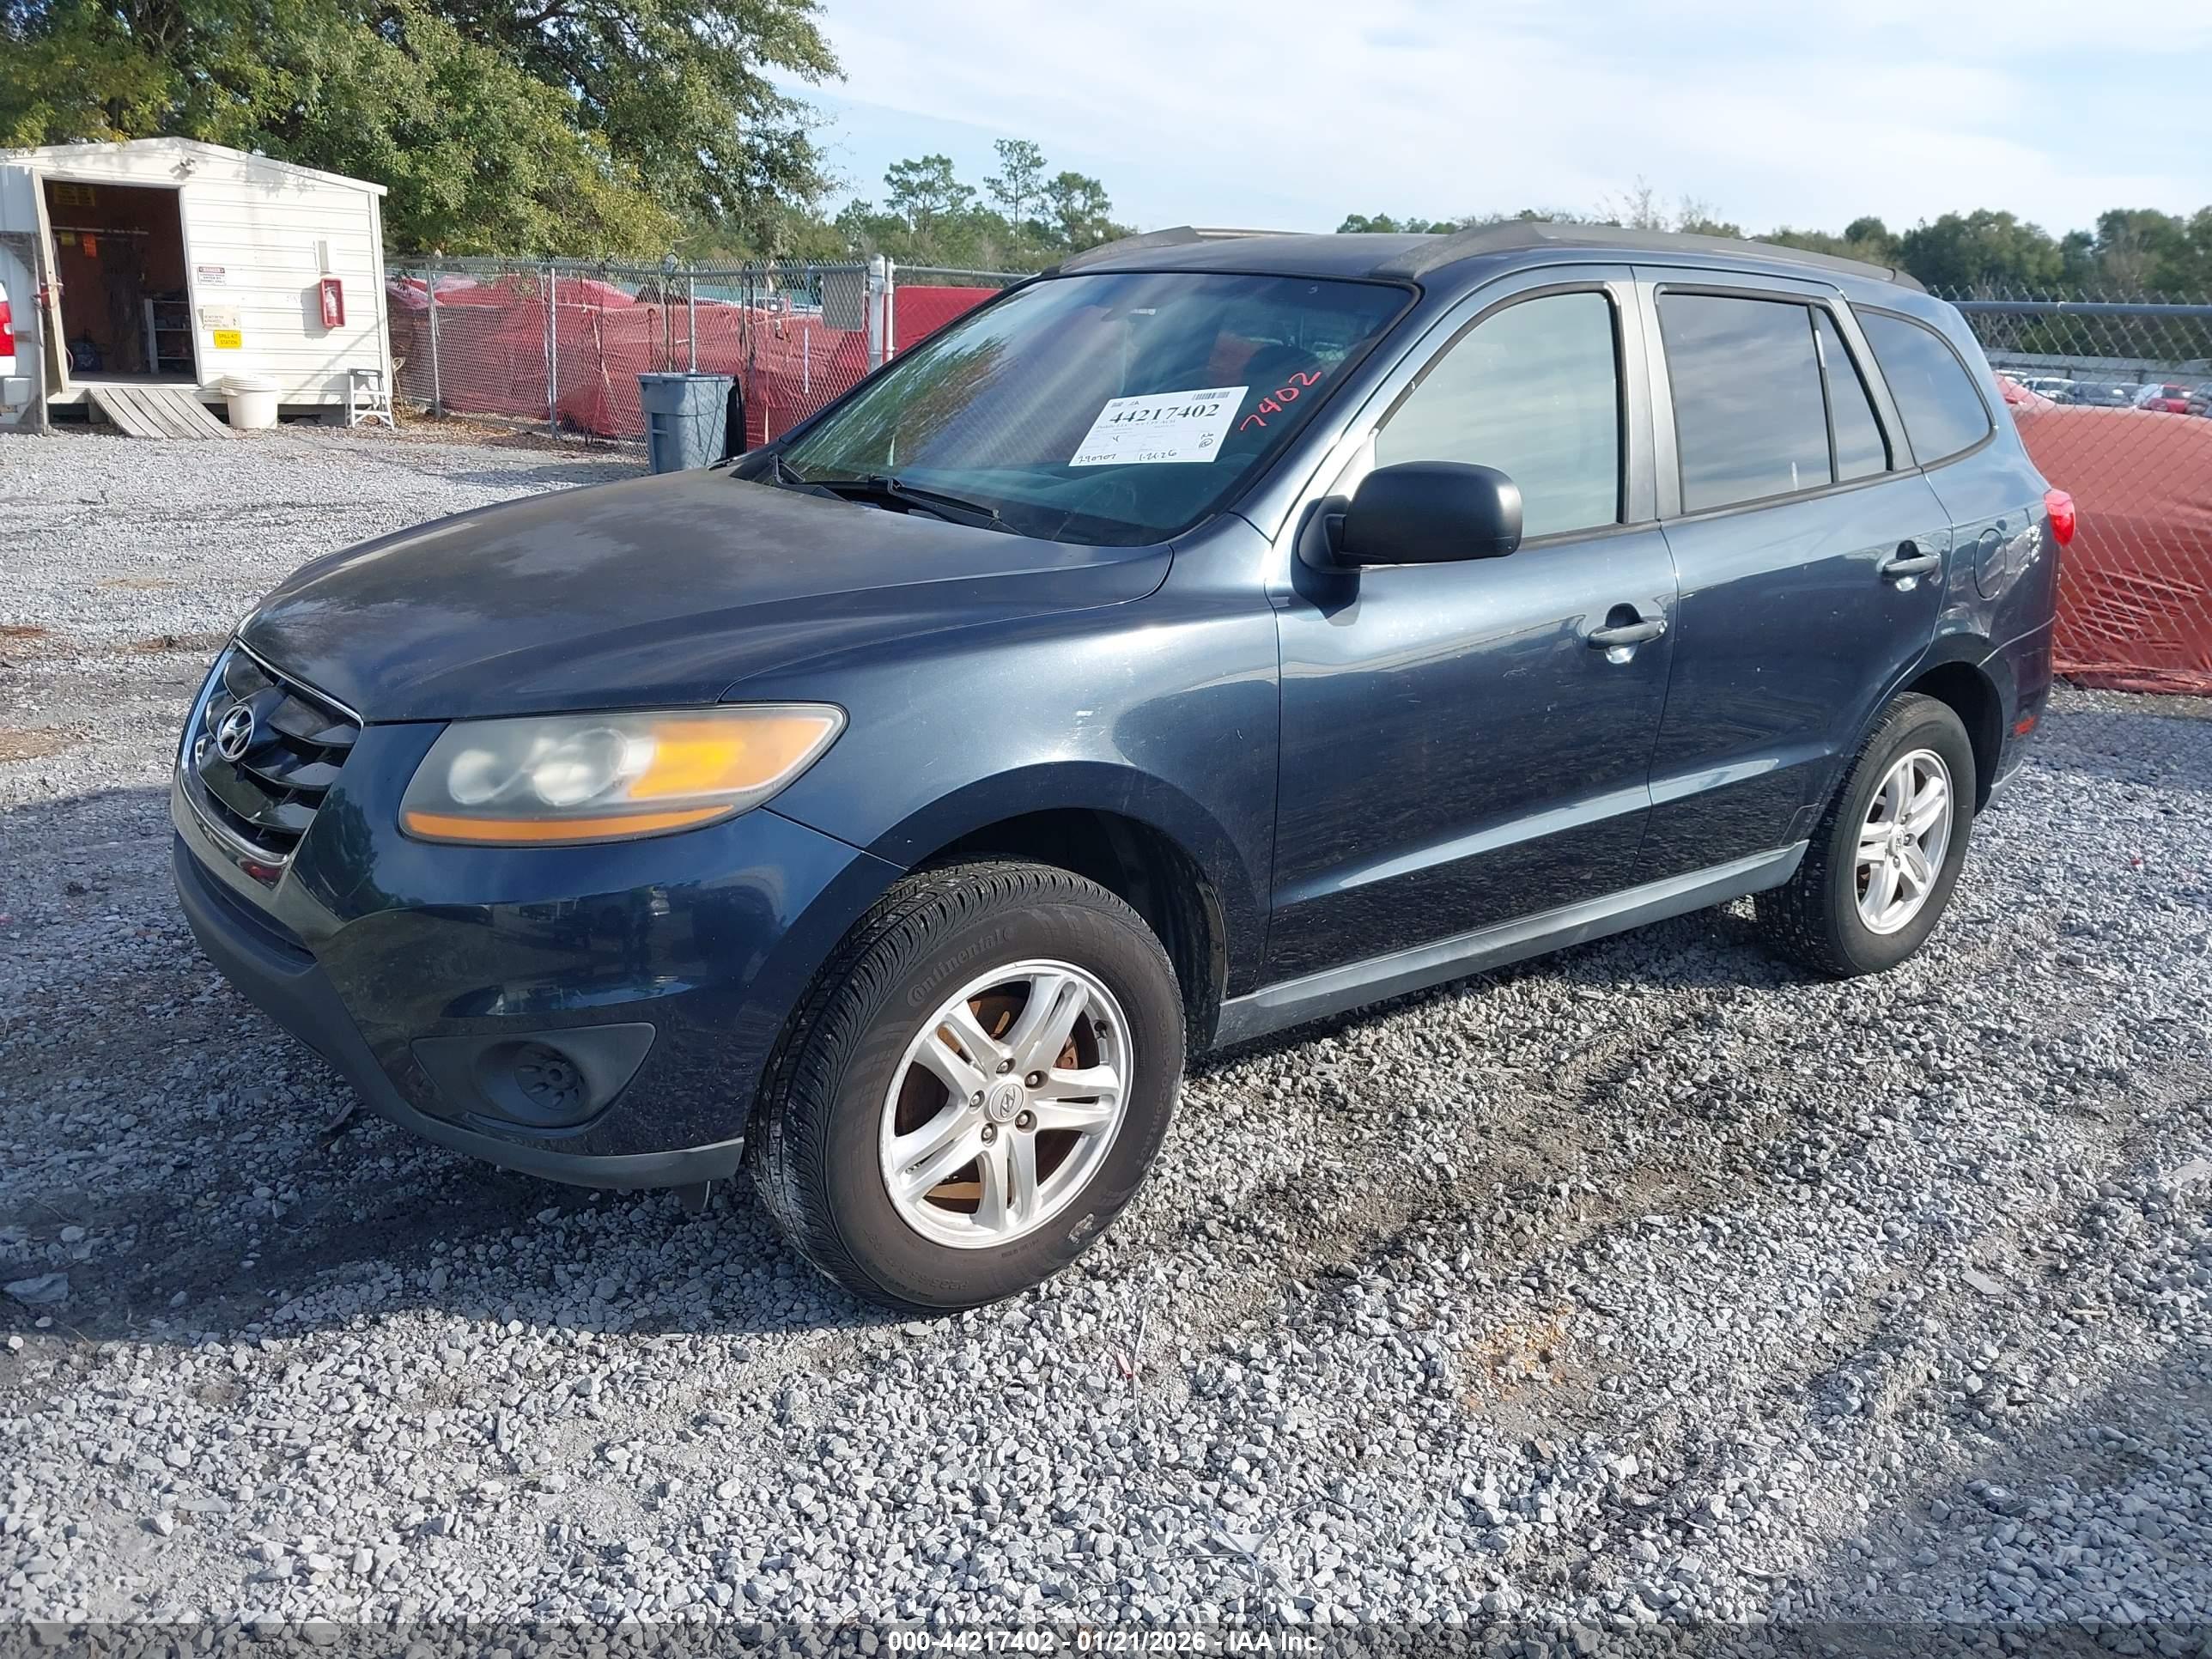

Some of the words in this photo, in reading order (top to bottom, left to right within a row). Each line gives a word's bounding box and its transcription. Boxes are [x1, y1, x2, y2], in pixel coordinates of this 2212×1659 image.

[1109, 404, 1220, 424] 44217402
[1239, 371, 1322, 431] 7402
[907, 928, 1001, 1006] Continental
